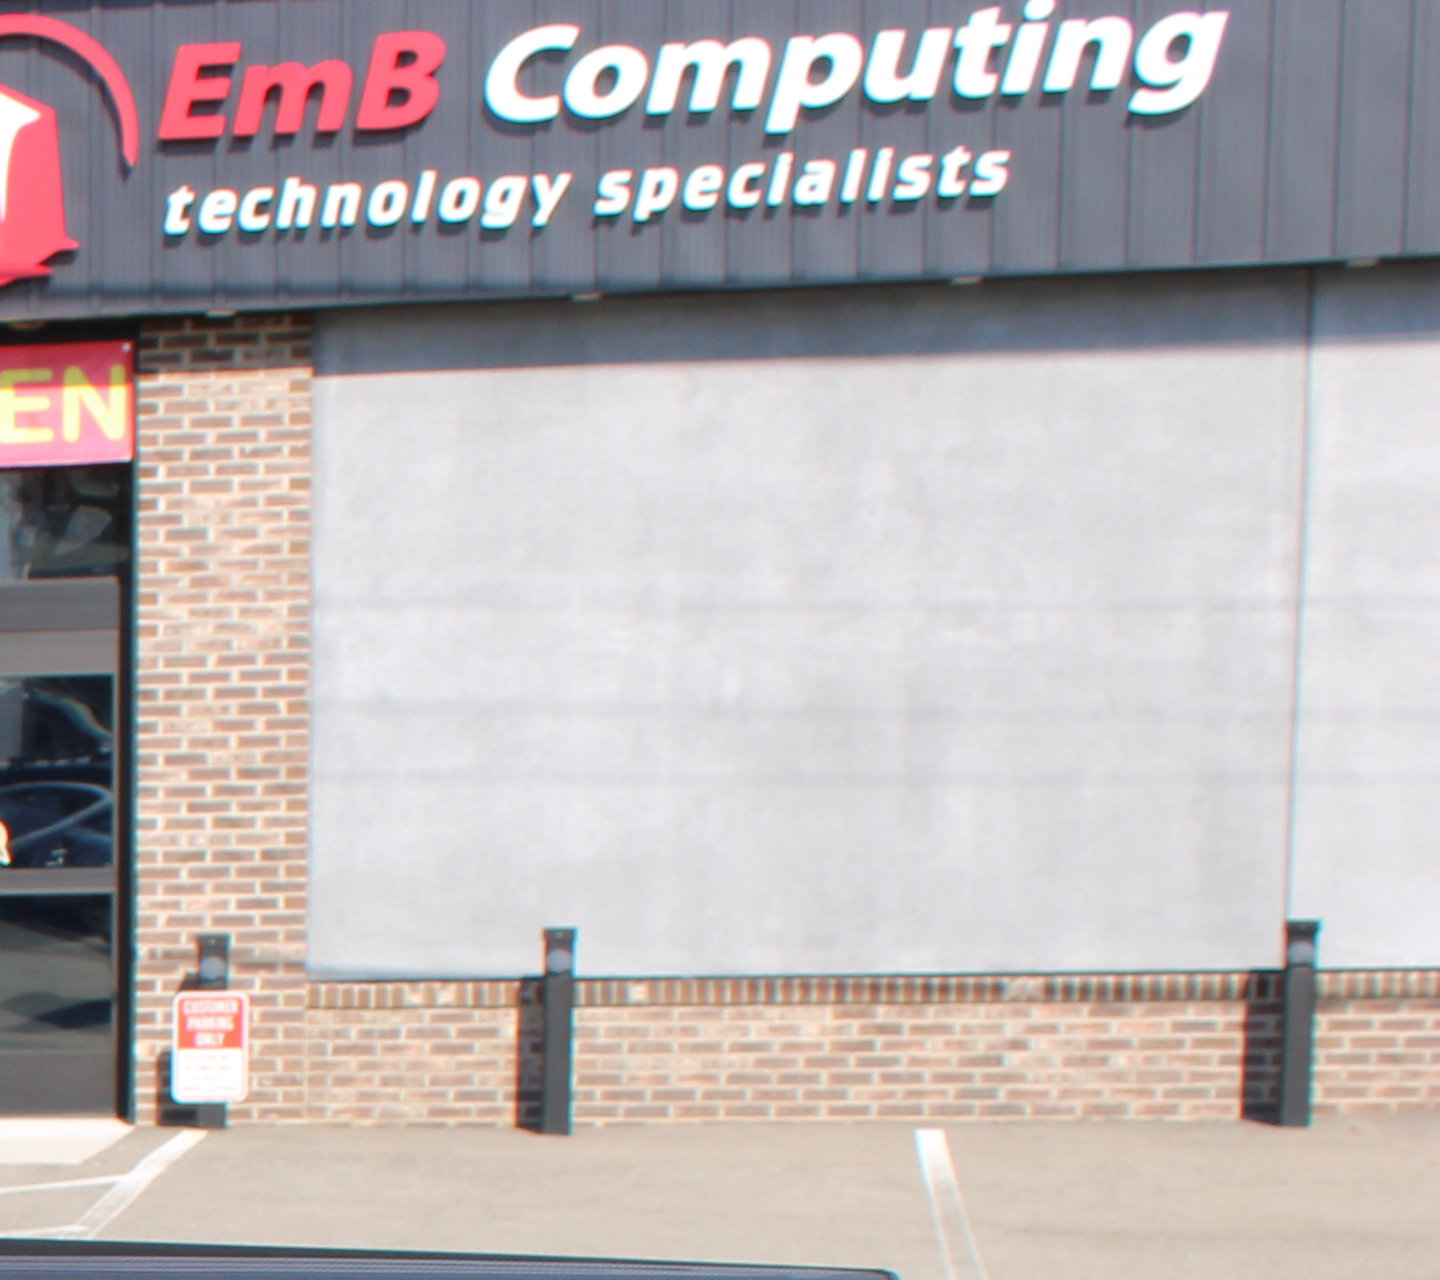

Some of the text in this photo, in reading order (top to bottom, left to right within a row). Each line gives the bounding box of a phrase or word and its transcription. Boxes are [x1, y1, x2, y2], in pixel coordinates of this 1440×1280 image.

[157, 0, 1229, 142] EmB Computing
[164, 145, 1012, 237] technology specialists
